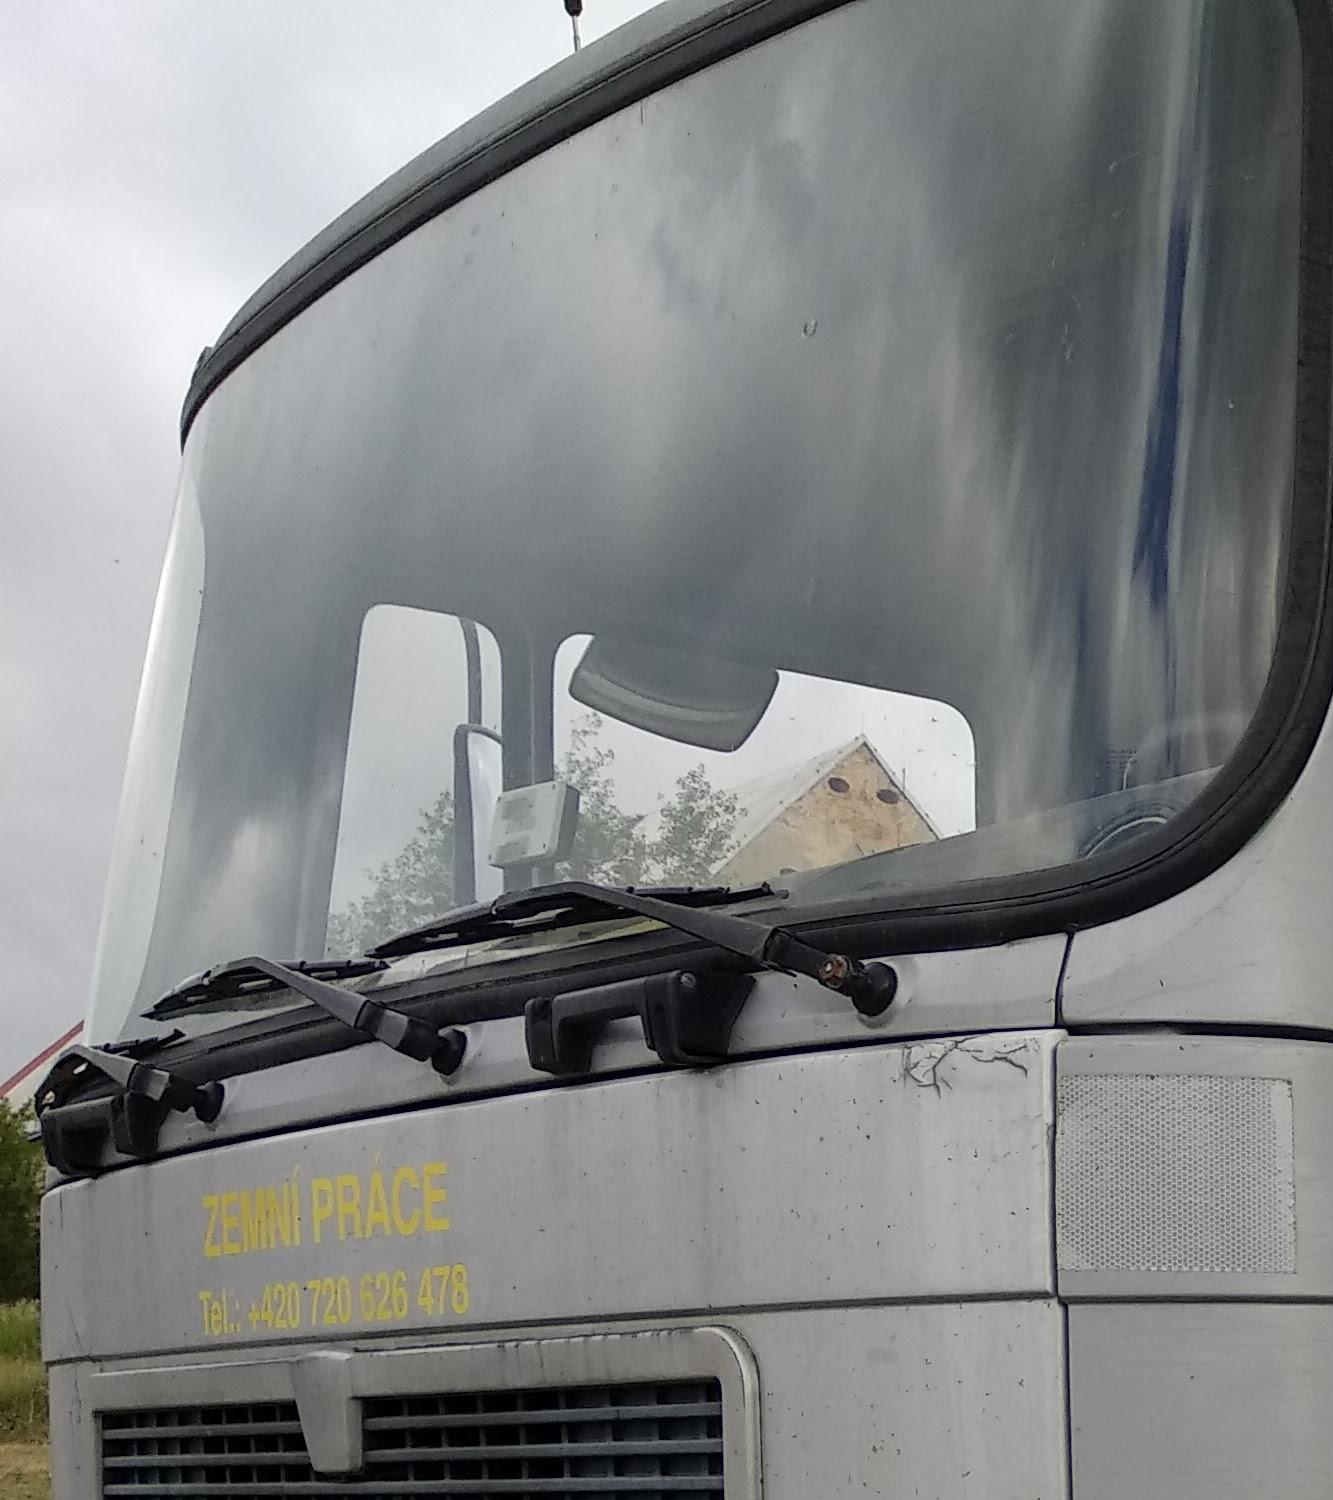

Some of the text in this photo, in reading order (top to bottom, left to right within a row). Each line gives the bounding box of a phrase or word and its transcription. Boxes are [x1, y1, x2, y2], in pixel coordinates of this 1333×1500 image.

[202, 1151, 450, 1259] ZEMNÍ PRÁCE
[198, 1263, 470, 1336] Tel.: +420 720 626 478
